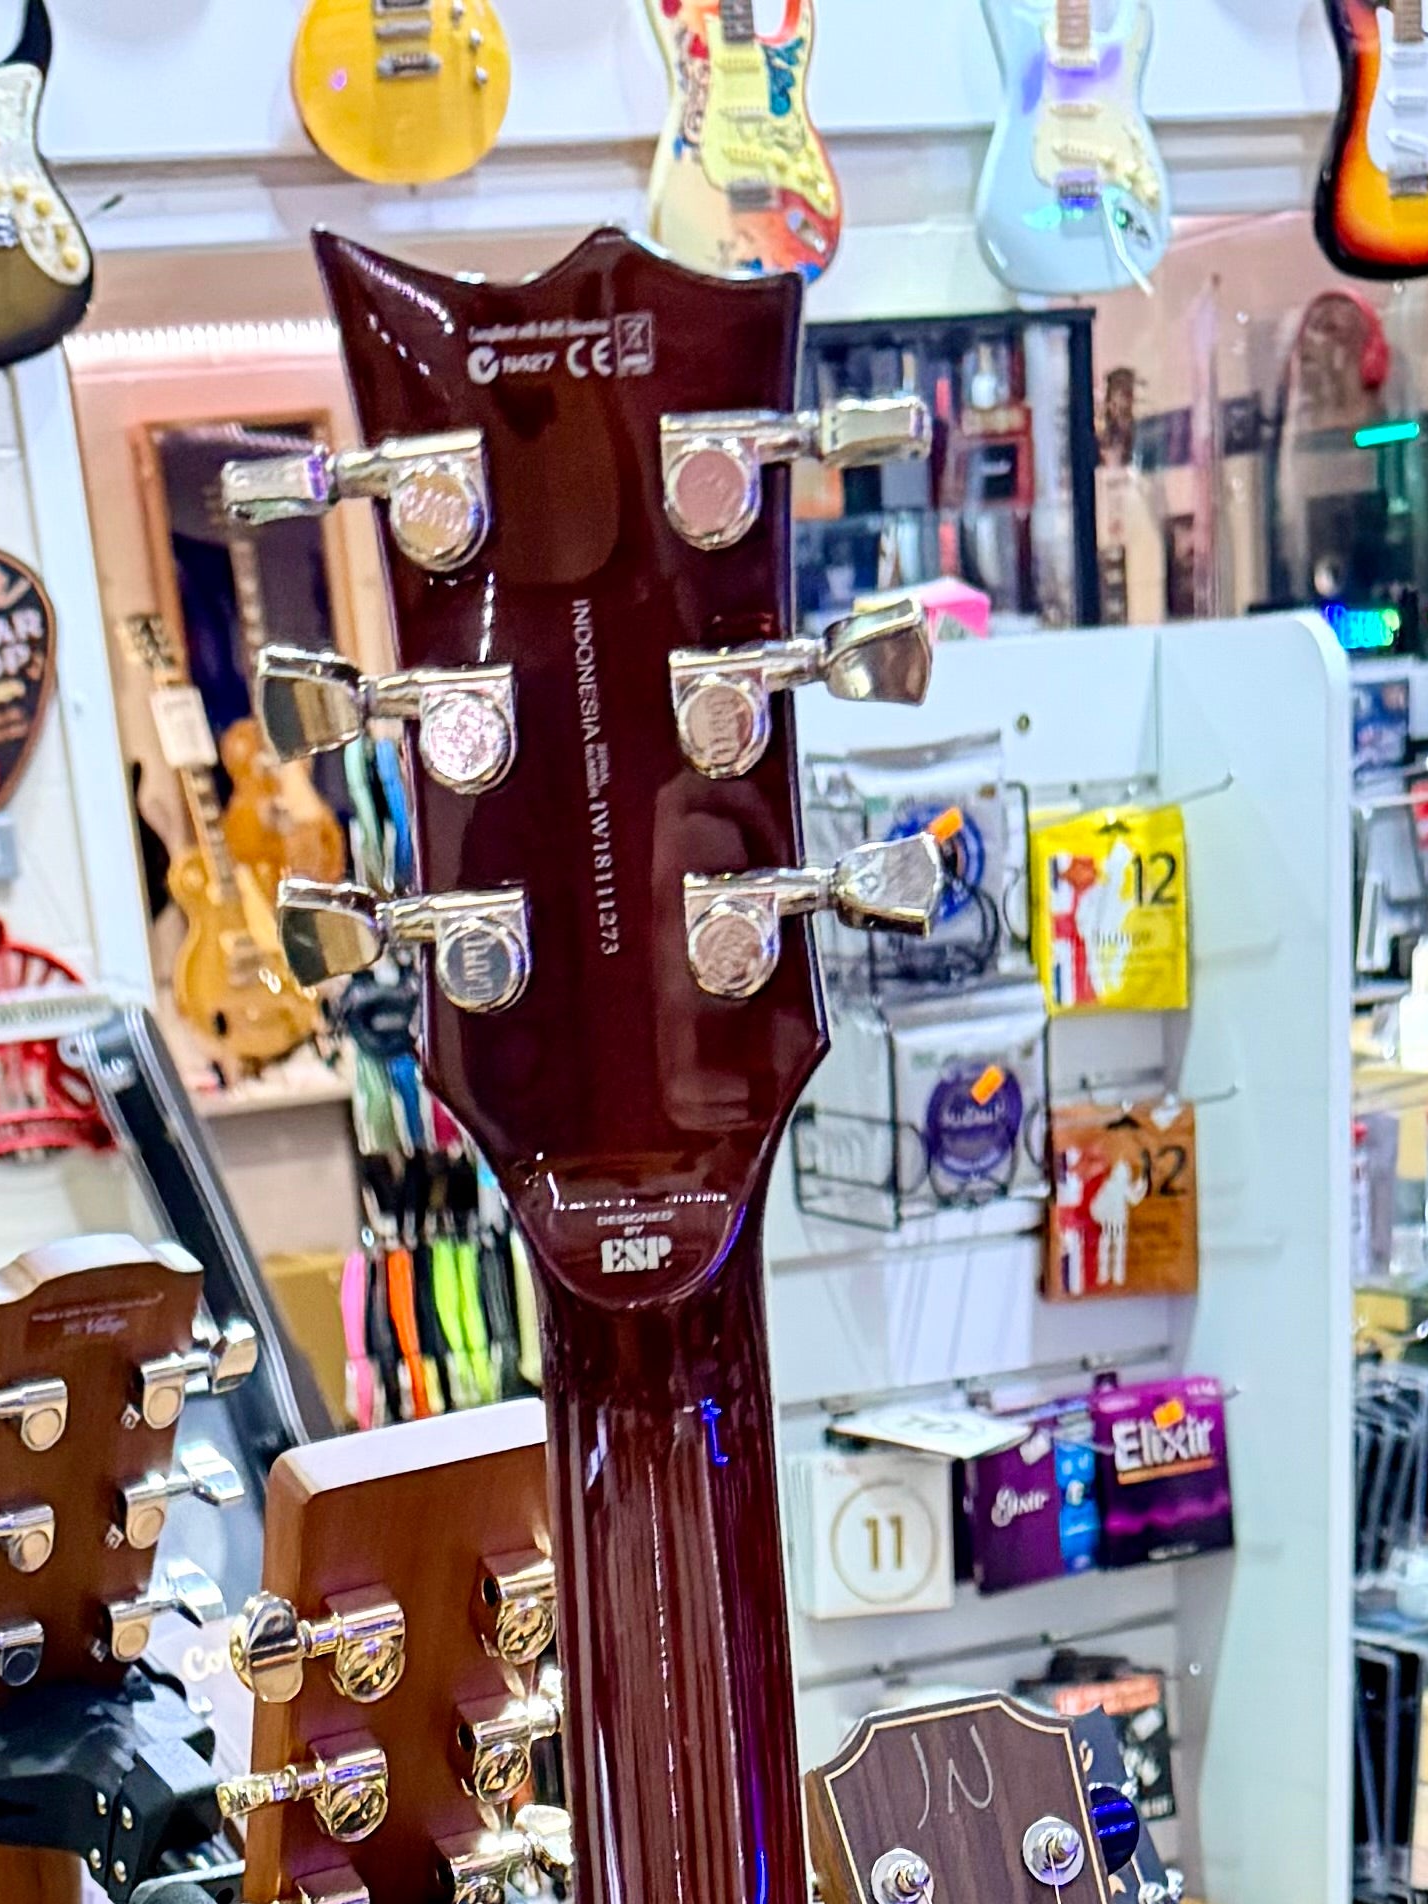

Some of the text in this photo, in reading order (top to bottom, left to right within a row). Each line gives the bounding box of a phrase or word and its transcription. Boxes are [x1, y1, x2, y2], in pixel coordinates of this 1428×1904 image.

[566, 337, 614, 379] CE
[571, 599, 602, 742] INDONESIA
[1133, 852, 1177, 908] 12
[1141, 1144, 1187, 1198] 12
[597, 1209, 675, 1227] DESIGNED
[601, 1235, 672, 1274] ESP
[1112, 1413, 1215, 1473] Elixir
[862, 1514, 906, 1572] 11
